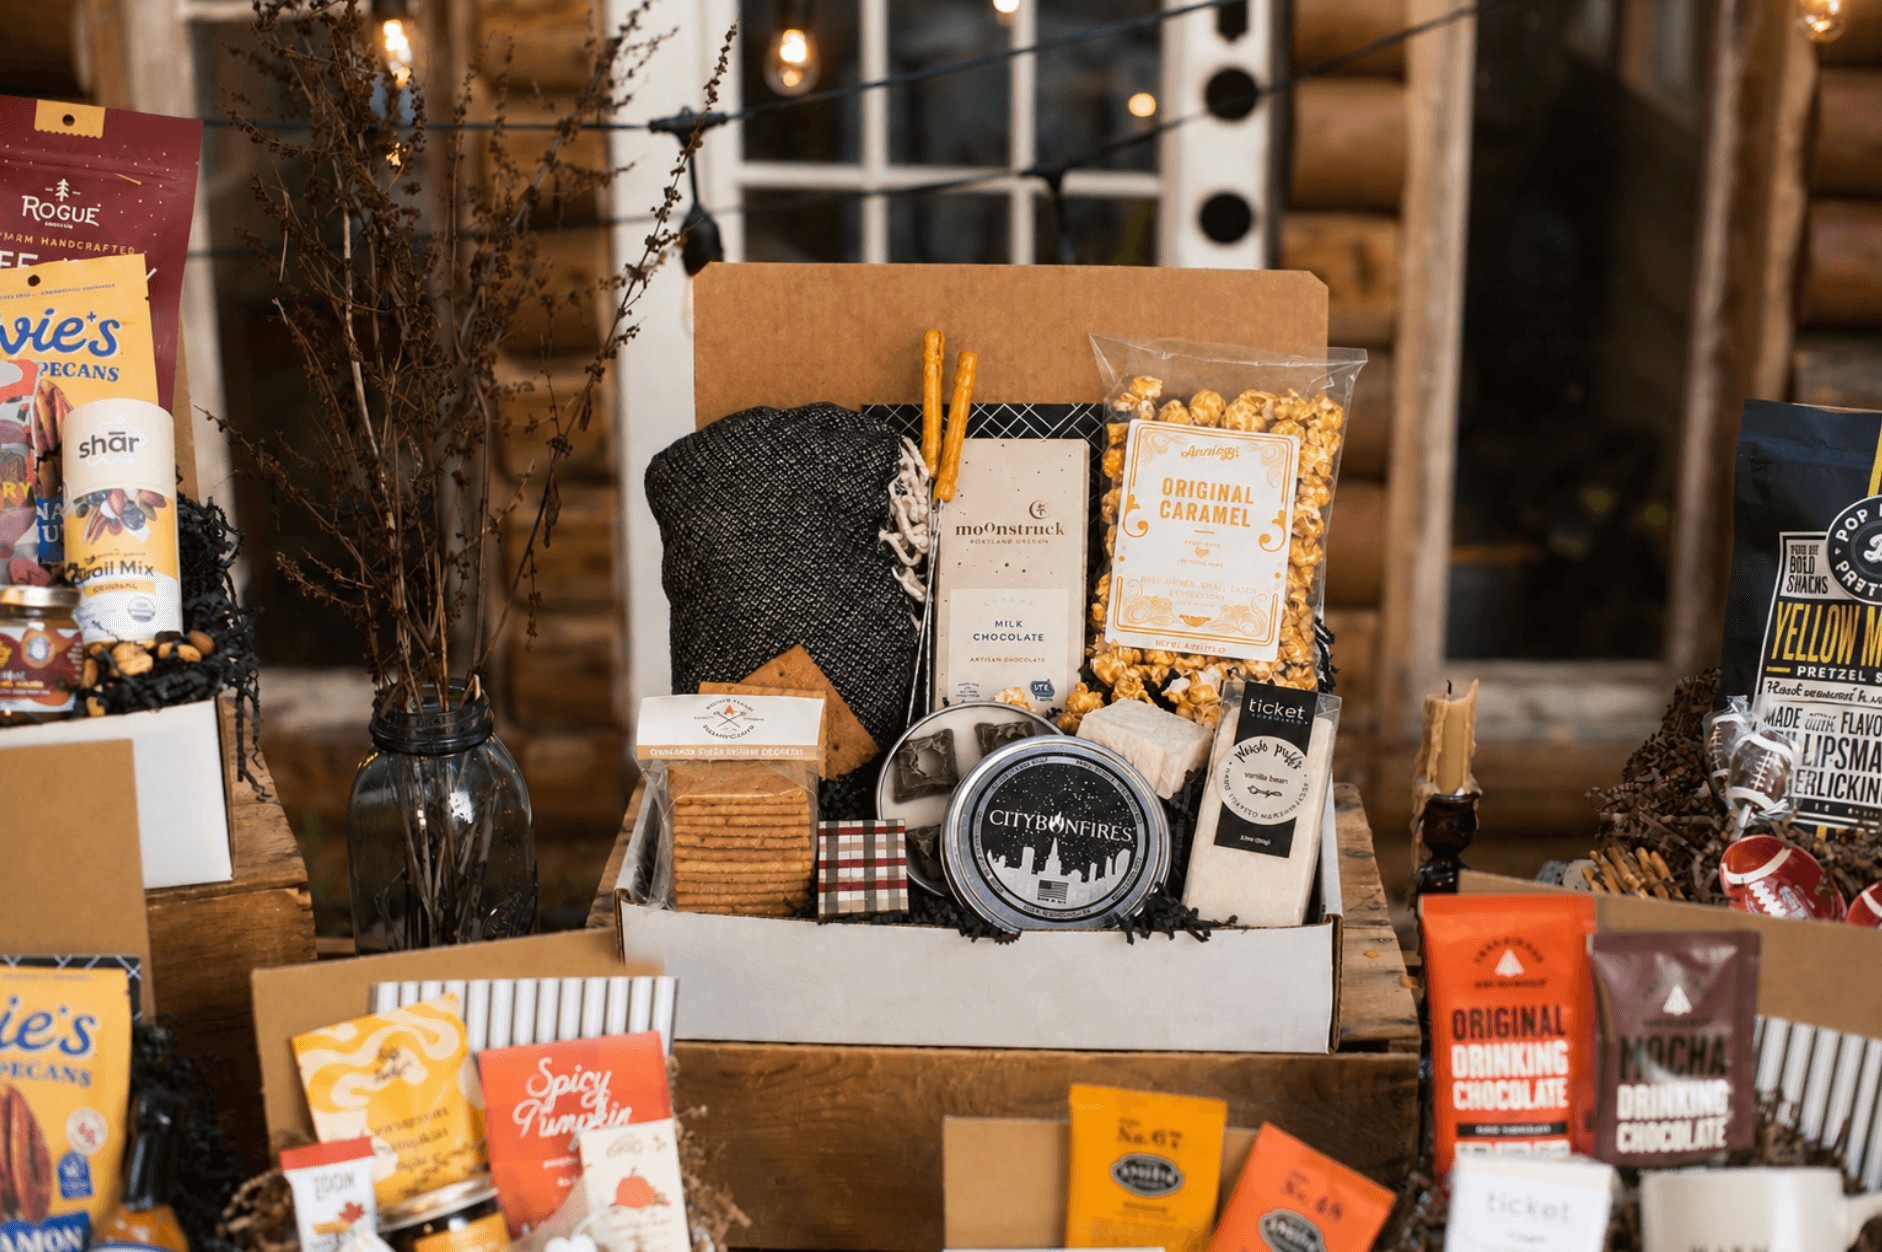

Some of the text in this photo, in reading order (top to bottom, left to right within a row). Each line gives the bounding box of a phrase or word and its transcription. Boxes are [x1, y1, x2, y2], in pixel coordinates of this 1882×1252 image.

[21, 195, 101, 227] ROGUE
[41, 236, 136, 255] HANDCRAFTED
[1161, 476, 1254, 505] ORIGINAL
[1158, 499, 1251, 528] CARAMEL
[1835, 508, 1868, 543] POP
[955, 521, 1066, 536] moonstruck
[119, 559, 154, 577] Mix
[1789, 555, 1816, 575] BOLD
[972, 633, 1045, 643] CHOCOLATE
[994, 620, 1023, 628] MILK
[1771, 600, 1861, 666] YELLOW
[1796, 665, 1867, 682] PRETZEL
[1248, 697, 1306, 720] ticket
[1764, 705, 1803, 729] MADE
[1244, 771, 1289, 785] vanilla bean
[1452, 1004, 1567, 1041] ORIGINAL
[1451, 1040, 1570, 1080] DRINKING
[1619, 1033, 1727, 1081] MOCHA
[526, 1056, 613, 1122] Spicy
[1452, 1076, 1569, 1112] CHOCOLATE
[1616, 1079, 1731, 1122] DRINKING
[1616, 1115, 1728, 1154] CHOCOLATE
